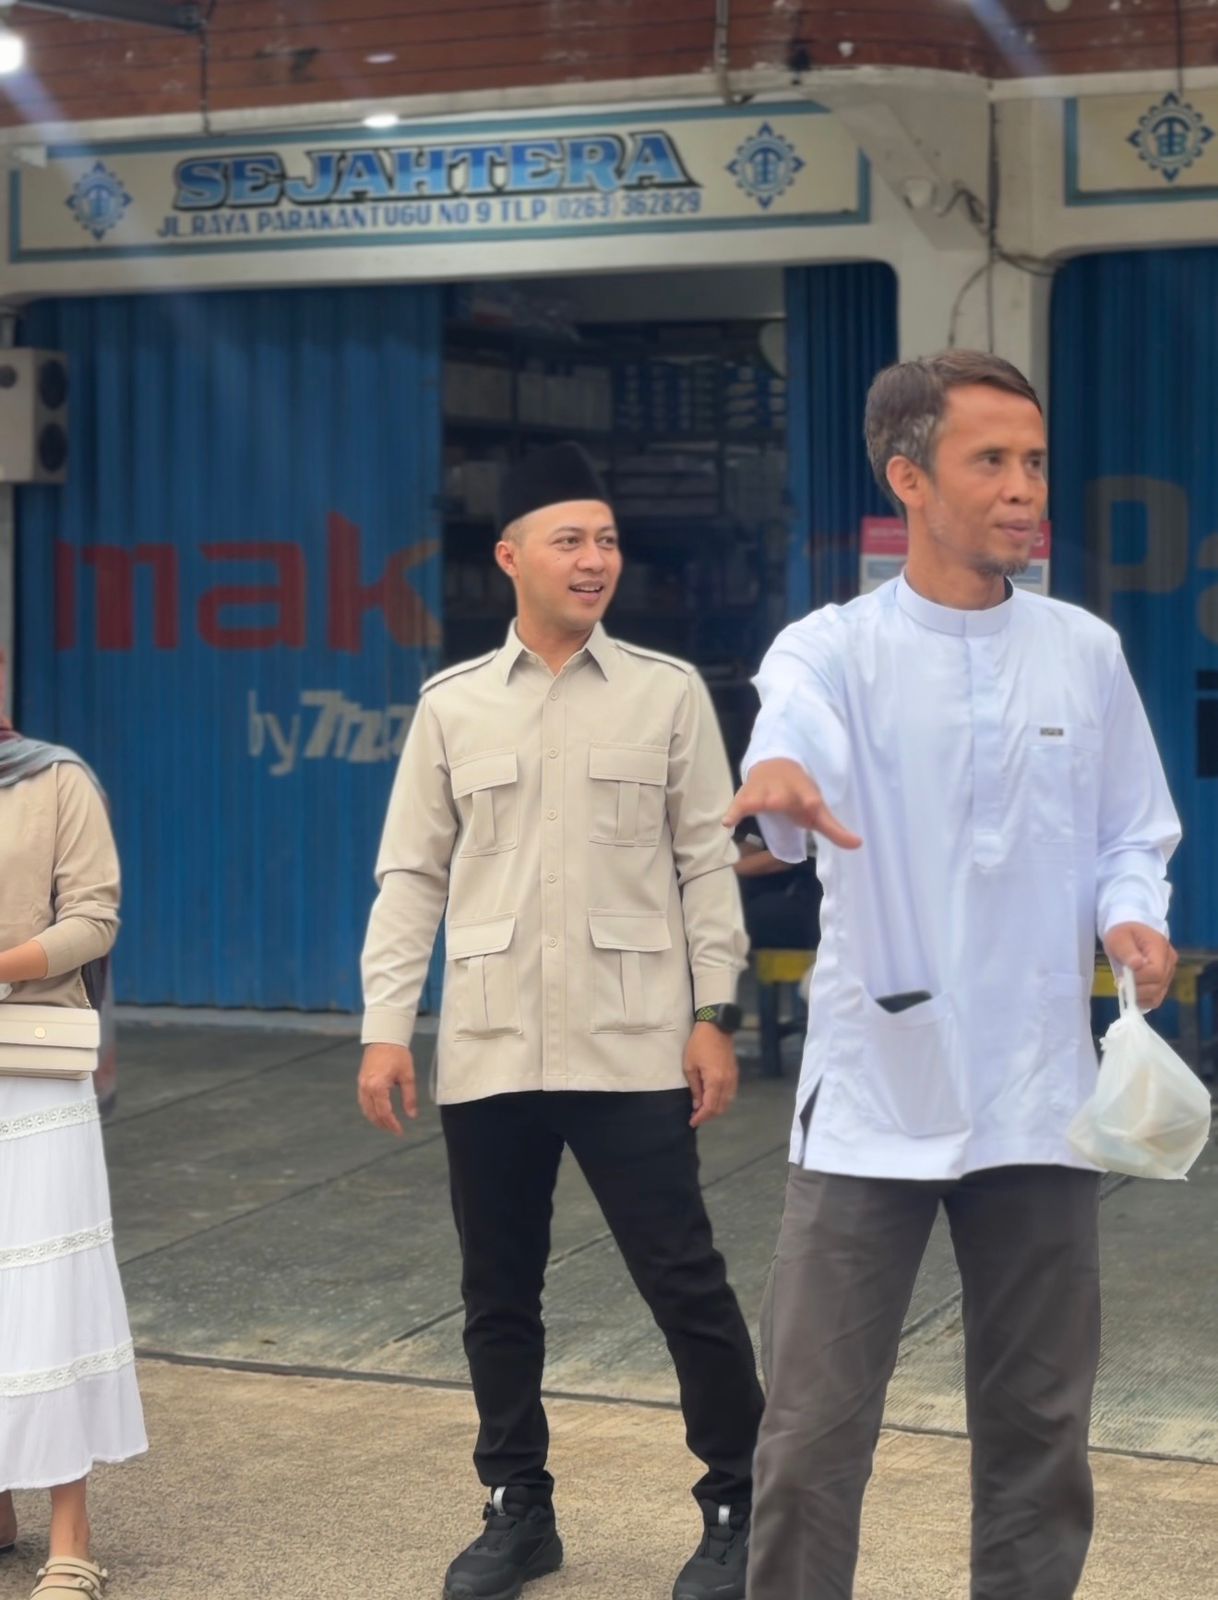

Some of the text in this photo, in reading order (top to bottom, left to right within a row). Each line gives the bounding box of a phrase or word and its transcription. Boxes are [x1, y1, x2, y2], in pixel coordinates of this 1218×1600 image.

[172, 130, 704, 212] SEJAHTERA
[191, 212, 250, 235] RAYA
[439, 202, 470, 224] NO
[475, 201, 491, 223] 9
[501, 199, 546, 222] TLP
[622, 191, 702, 216] 362829
